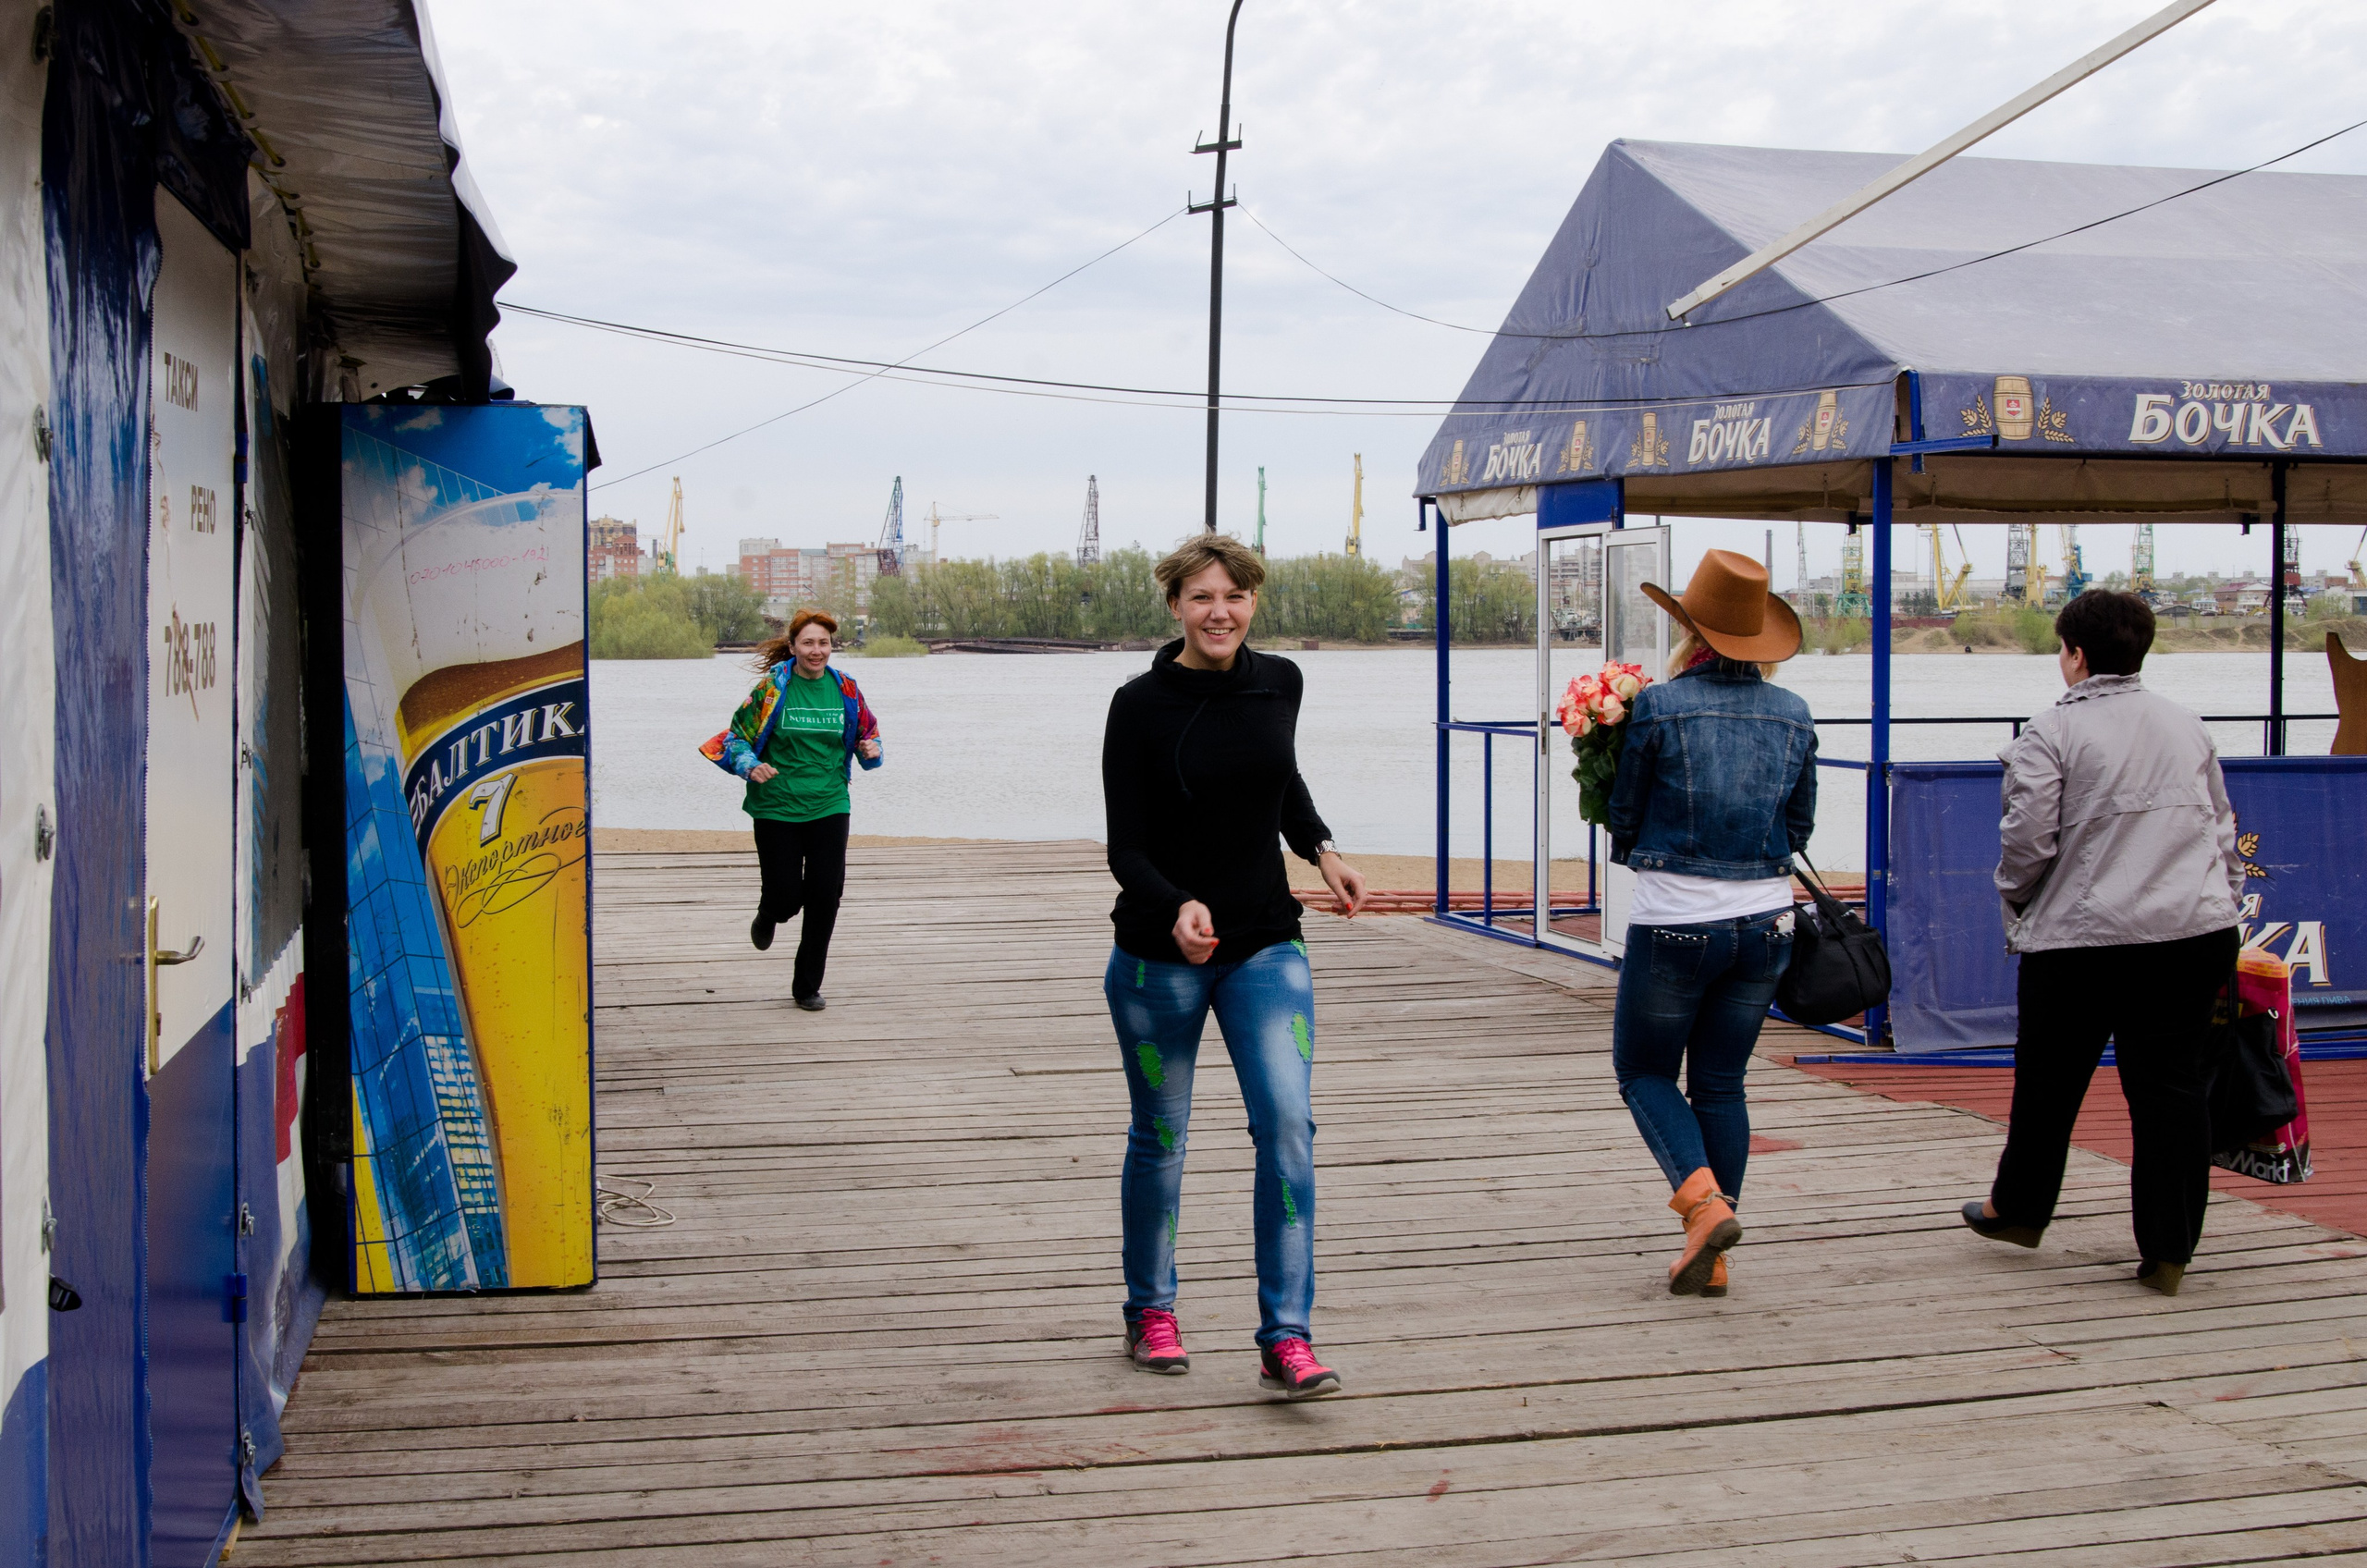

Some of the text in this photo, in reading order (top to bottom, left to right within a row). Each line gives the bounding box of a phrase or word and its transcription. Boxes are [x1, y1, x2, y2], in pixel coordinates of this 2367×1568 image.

[164, 351, 199, 412] ТАКСИ
[2178, 380, 2272, 401] ЗОЛОТАЯ
[1712, 401, 1755, 423] ЗОЛОТАЯ
[2128, 393, 2324, 451] БОЧКА
[1482, 442, 1542, 482] БОЧКА
[1686, 417, 1772, 465] БОЧКА
[190, 484, 216, 535] РЕНО
[165, 621, 215, 697] 788-788
[789, 714, 839, 724] NUTRILITE
[410, 701, 585, 839] БАЛТИК
[469, 772, 518, 848] 7
[2322, 995, 2351, 1004] ПИВА
[2229, 1150, 2290, 1182] Markt
